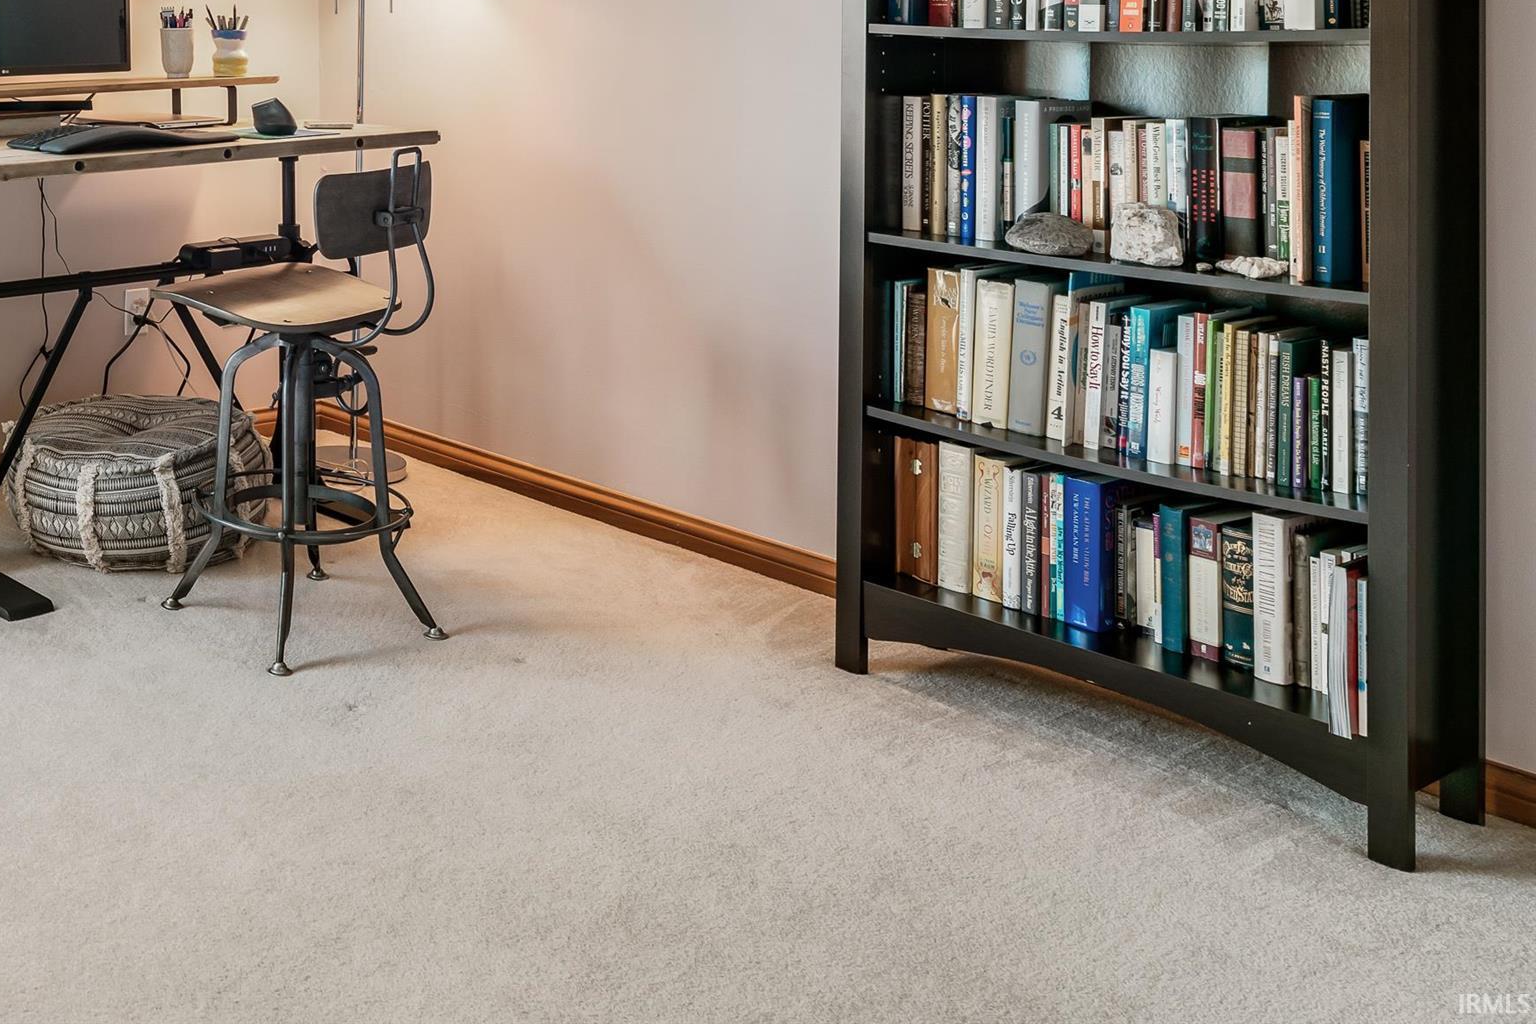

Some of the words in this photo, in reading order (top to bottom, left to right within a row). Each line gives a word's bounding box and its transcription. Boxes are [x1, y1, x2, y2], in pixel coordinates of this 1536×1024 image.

[904, 104, 914, 139] KEEPING
[1152, 127, 1161, 145] White
[1319, 139, 1327, 154] World
[904, 142, 913, 179] SECRETS
[986, 307, 998, 341] FAMILY
[1058, 318, 1068, 349] English
[1091, 326, 1104, 348] How
[983, 343, 995, 370] WORD
[1092, 350, 1101, 361] to
[1120, 348, 1130, 369] you
[1282, 352, 1292, 372] IRISH
[1056, 367, 1065, 396] Action
[1089, 363, 1102, 381] Say
[1195, 371, 1206, 385] JOB
[983, 372, 994, 410] FINDER
[1089, 382, 1101, 390] It
[1281, 375, 1290, 407] DREAMS
[1052, 406, 1063, 421] 4
[1312, 409, 1320, 419] The
[1312, 421, 1320, 444] Meaning
[1312, 454, 1320, 465] Life
[984, 477, 994, 514] WIZARD
[1005, 512, 1017, 541] Falling
[1024, 516, 1037, 534] Light
[1006, 543, 1016, 556] Up
[1025, 558, 1037, 577] Attic
